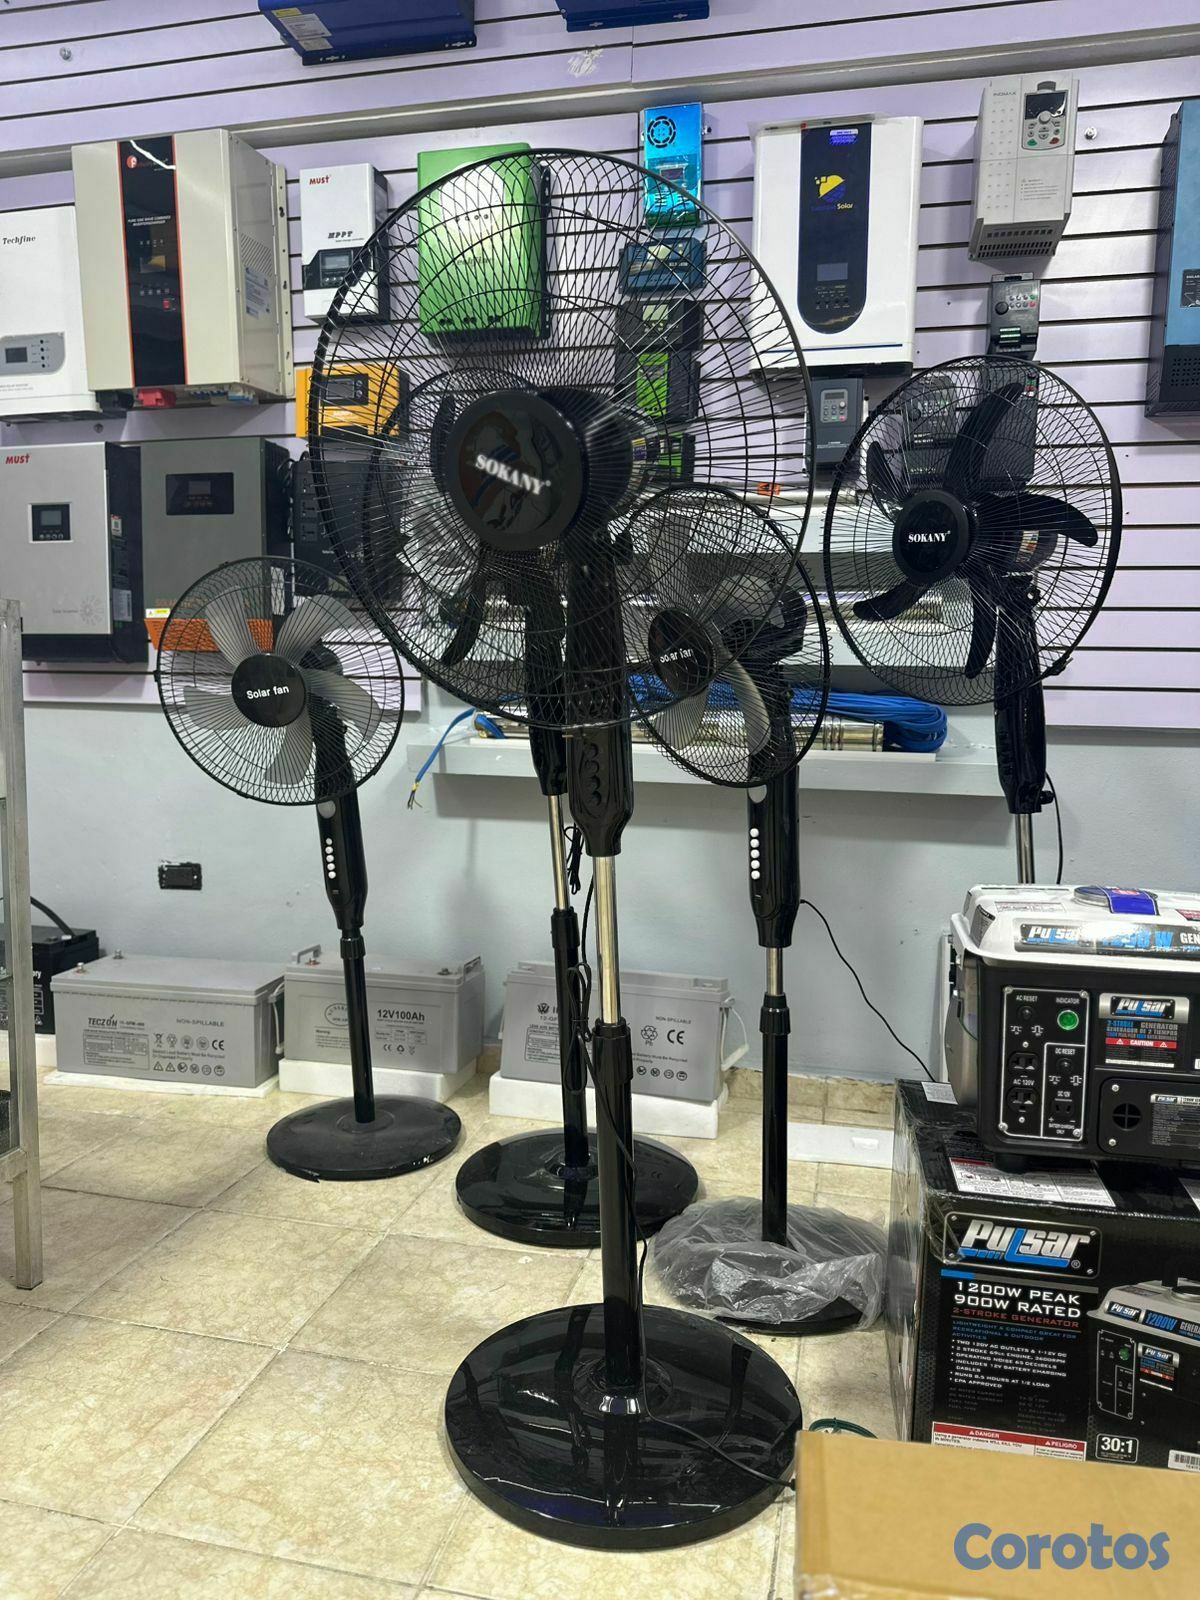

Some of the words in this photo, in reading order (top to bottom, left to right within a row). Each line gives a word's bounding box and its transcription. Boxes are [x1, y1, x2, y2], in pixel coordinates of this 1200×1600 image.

[309, 175, 330, 185] MUST
[2, 235, 36, 245] Techfine
[328, 230, 353, 239] MPPT
[5, 453, 30, 464] MUST
[475, 454, 545, 495] SOKANY
[908, 532, 947, 543] SOKANY
[246, 688, 270, 700] Solar
[272, 685, 290, 695] fan
[1115, 998, 1171, 1017] Pulsar
[377, 1009, 425, 1021] 12V100Ah
[1140, 1022, 1178, 1030] GENERATOR
[1130, 1039, 1154, 1047] CAUTION
[959, 1219, 1091, 1268] Pulsar
[957, 1281, 1022, 1298] 1200W
[1029, 1289, 1080, 1305] PEAK
[954, 1294, 1010, 1310] 900W
[1017, 1301, 1081, 1318] RATED
[952, 1307, 1008, 1320] 2-STROKE
[1011, 1314, 1080, 1328] GENERATOR
[1145, 1312, 1178, 1331] 1200W
[962, 1347, 988, 1355] STROKE
[1000, 1345, 1029, 1353] OUTLETS
[955, 1352, 992, 1361] OPERATING
[993, 1356, 1014, 1364] NOISE
[1025, 1360, 1057, 1370] DECIBELS
[955, 1359, 988, 1367] INCLUDES
[1003, 1364, 1031, 1373] BATTERY
[956, 1365, 981, 1373] CABLES
[968, 1379, 1003, 1388] APPROVED
[986, 1375, 1010, 1383] HOURS
[975, 1430, 1000, 1439] DANGER
[1051, 1441, 1078, 1450] PELIGRO
[1101, 1437, 1133, 1453] 30:1
